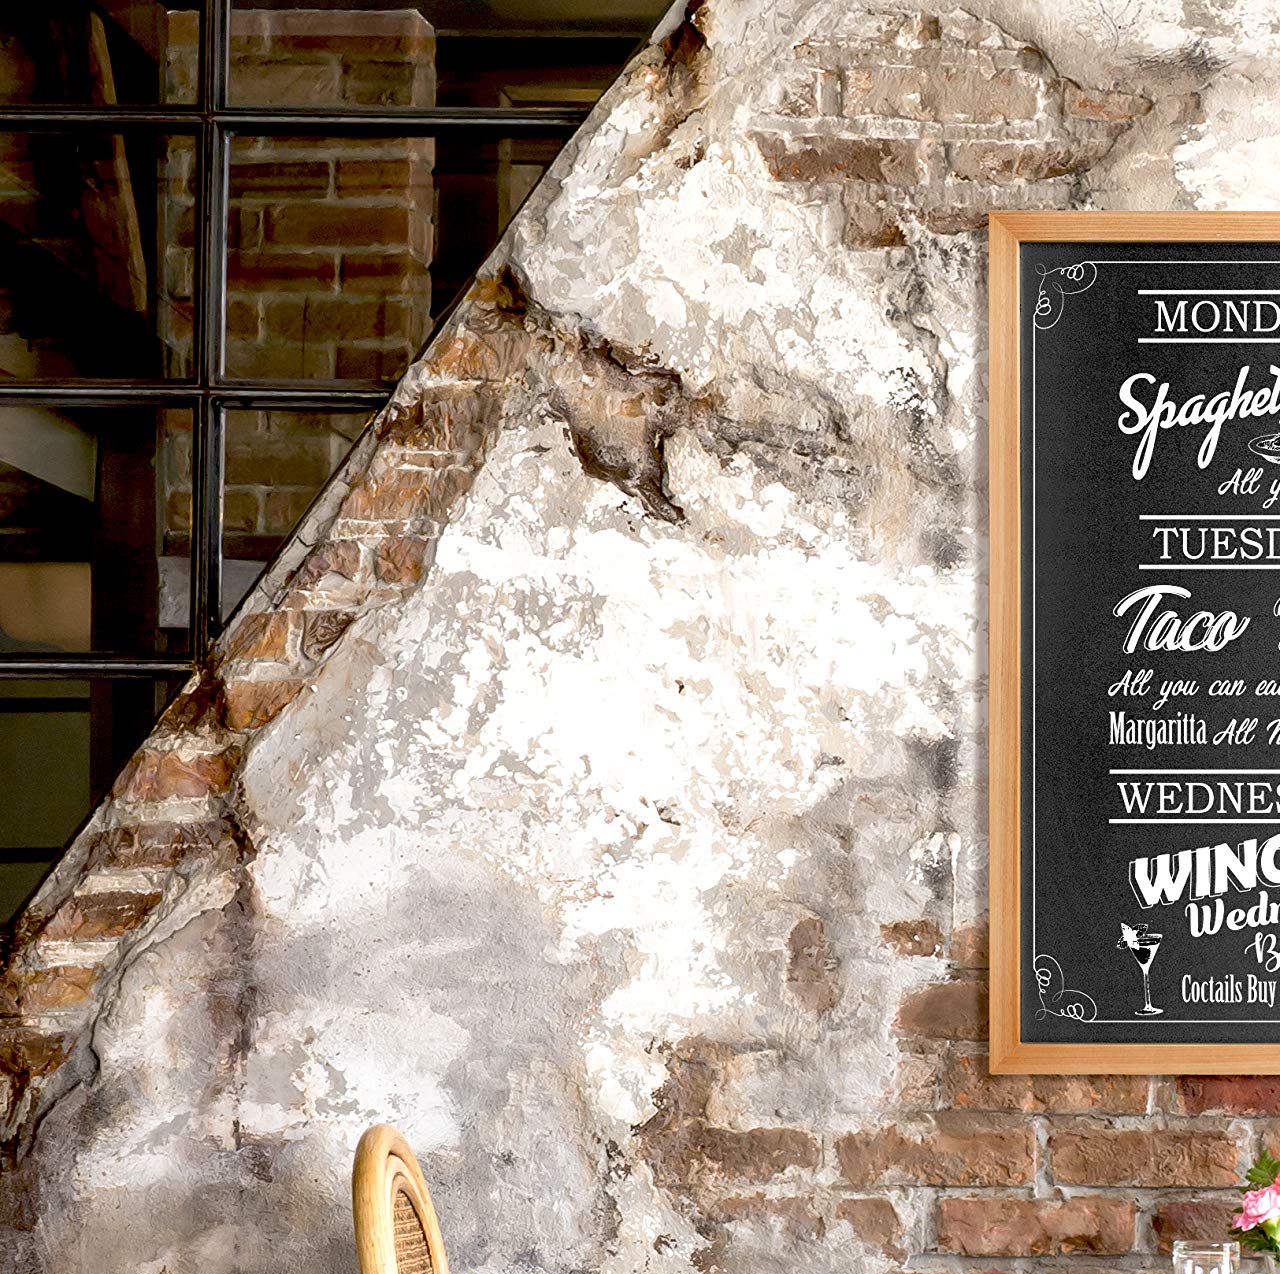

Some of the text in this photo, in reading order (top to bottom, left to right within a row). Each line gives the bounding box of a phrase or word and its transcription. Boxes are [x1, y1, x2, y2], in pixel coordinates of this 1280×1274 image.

[1217, 467, 1264, 496] All
[1112, 584, 1251, 655] Taco
[1107, 668, 1154, 697] All
[1152, 679, 1200, 711] you
[1208, 679, 1247, 696] can
[1108, 711, 1208, 750] Margaritta
[1212, 717, 1259, 746] All
[1181, 973, 1243, 1003] Coctails
[1246, 974, 1277, 1008] Buy
